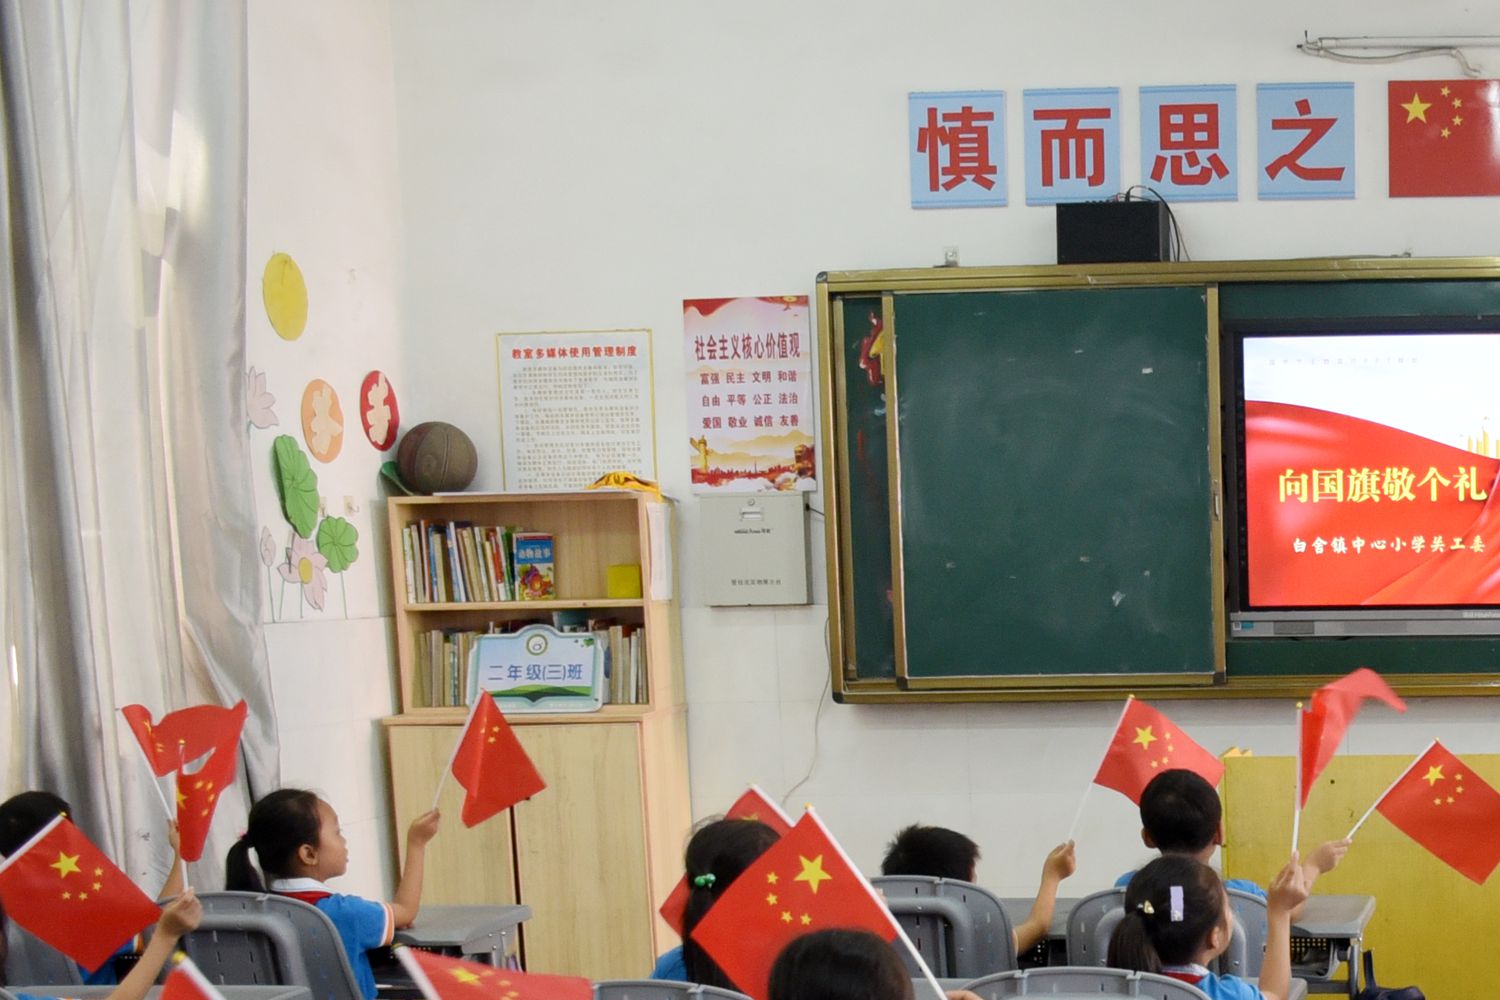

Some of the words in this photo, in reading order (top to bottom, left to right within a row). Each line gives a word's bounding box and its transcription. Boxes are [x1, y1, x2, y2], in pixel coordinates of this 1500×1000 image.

[917, 99, 1346, 190] 慎而思之
[512, 345, 637, 359] 教室多媒体使用管理制度
[695, 332, 800, 360] 社会主义核心价值观
[700, 373, 720, 384] 富强
[726, 372, 746, 384] 民主
[752, 371, 771, 383] 文明
[778, 370, 797, 382] 和谐
[702, 395, 720, 407] 自由
[728, 394, 746, 406] 平等
[753, 393, 772, 405] 公正
[779, 392, 798, 404] 法治
[703, 416, 721, 429] 爱国
[728, 416, 747, 428] 敬业
[754, 415, 773, 427] 诚信
[780, 414, 798, 426] 友善
[1279, 466, 1488, 503] 向国旗敬个礼
[1293, 535, 1485, 554] 白舍镇中心小学关工委
